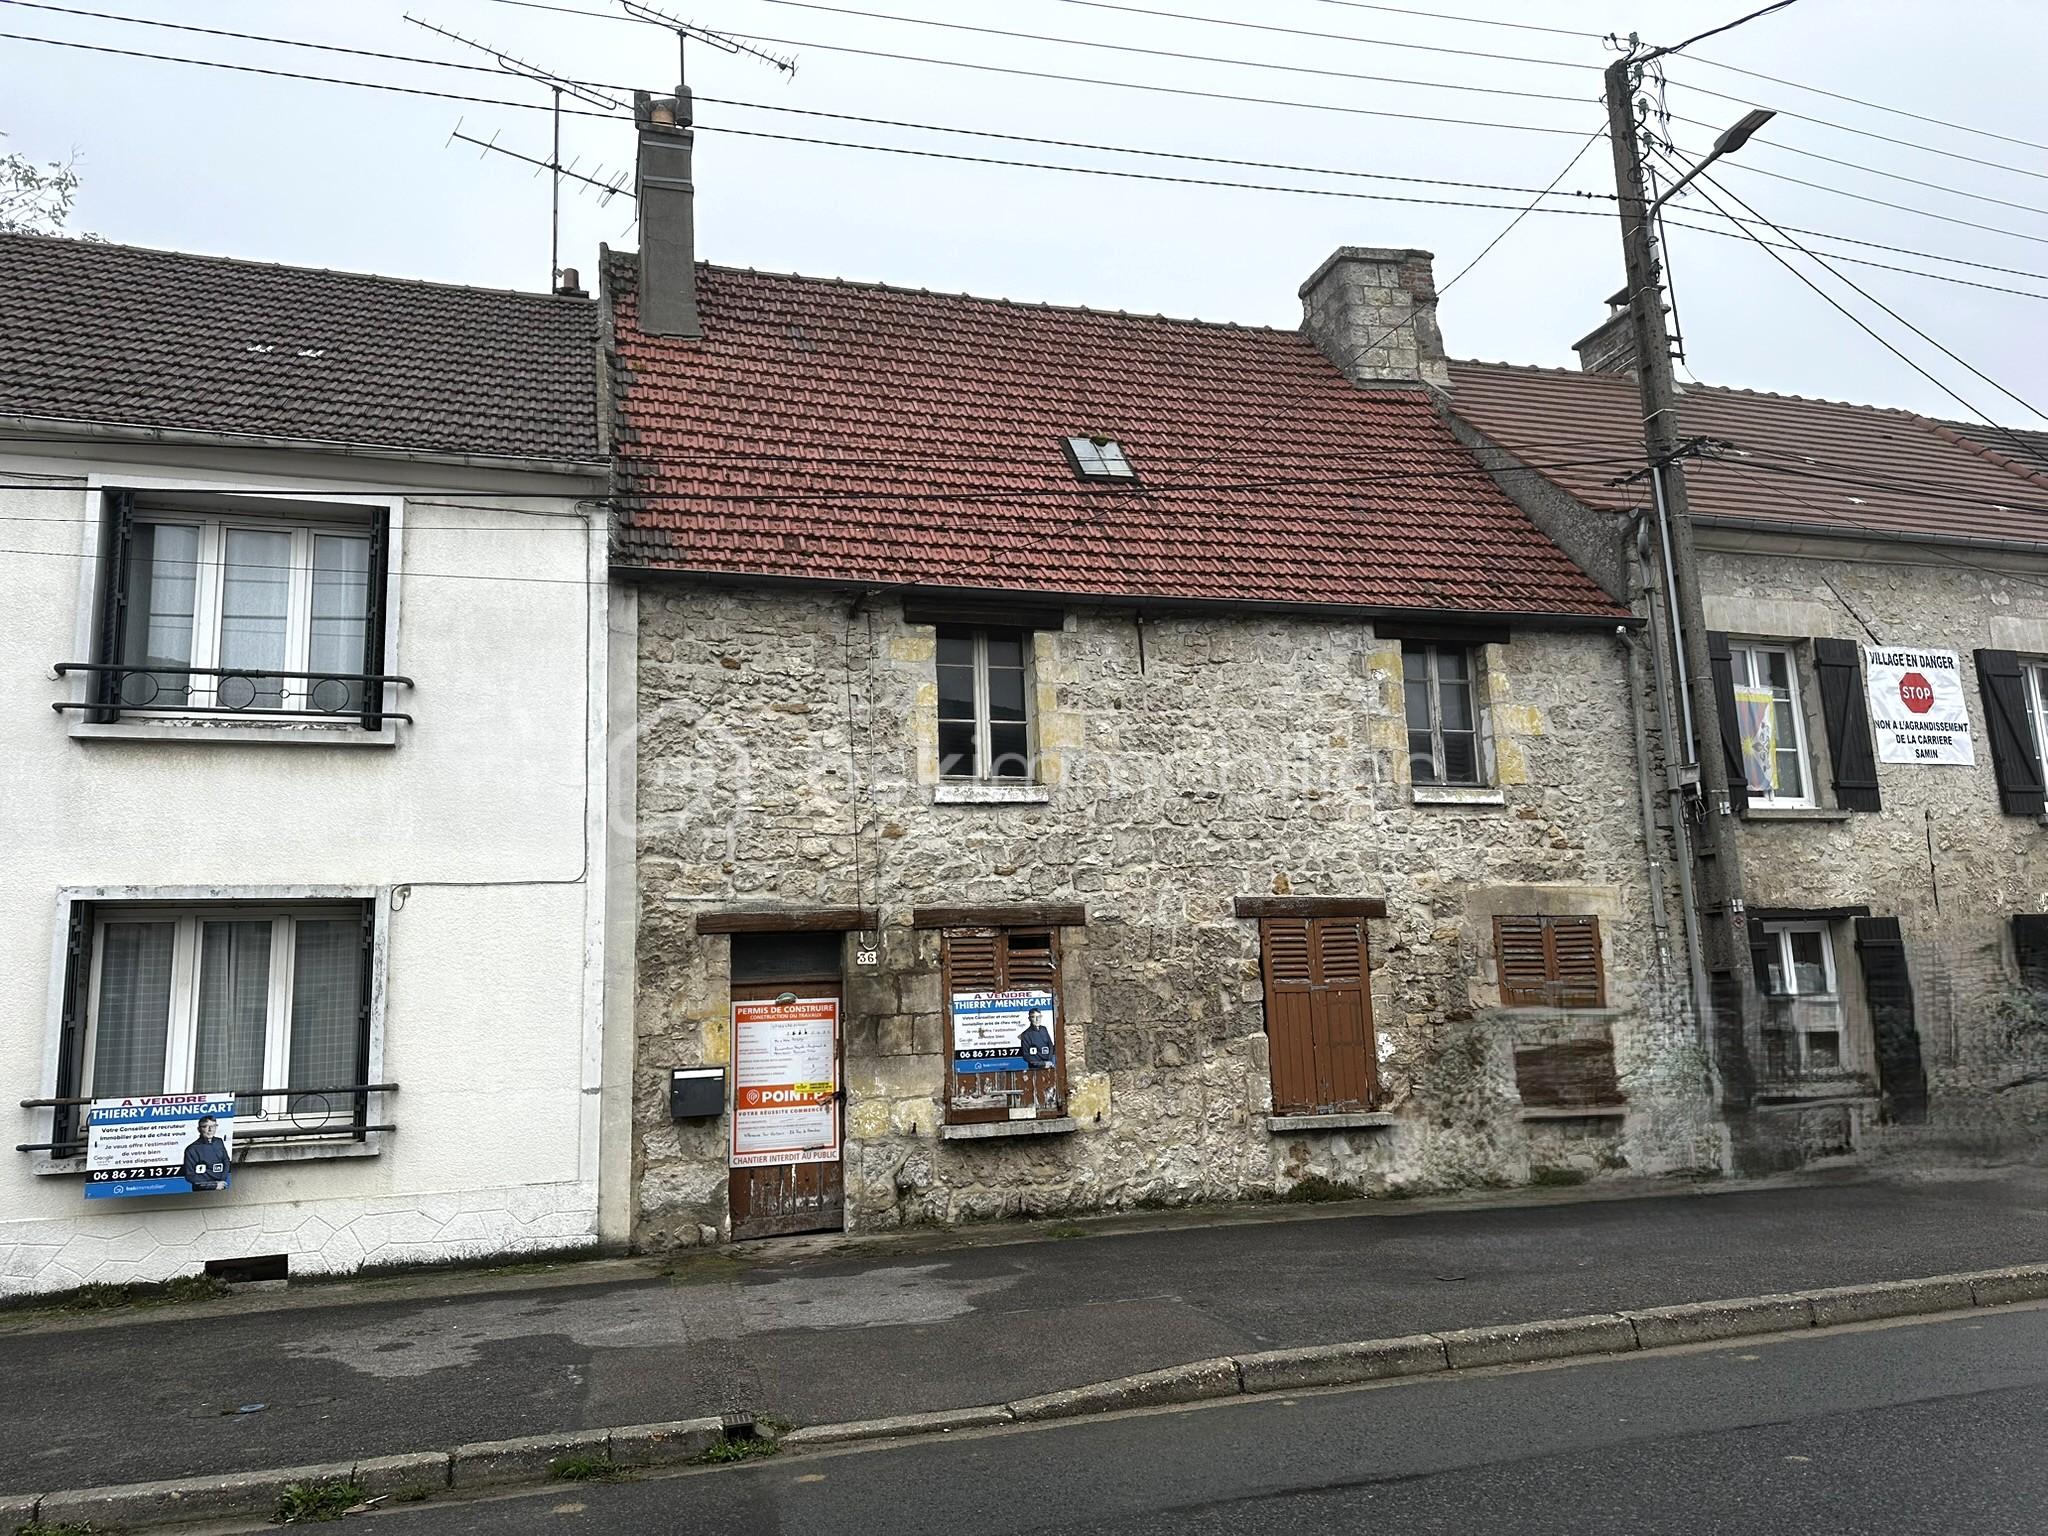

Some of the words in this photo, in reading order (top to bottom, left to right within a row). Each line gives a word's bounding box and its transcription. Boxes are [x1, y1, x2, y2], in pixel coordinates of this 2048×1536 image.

[1869, 651, 1905, 666] VILLAGE
[1906, 653, 1918, 667] EN
[1919, 655, 1955, 669] DANGER
[1902, 686, 1931, 700] STOP
[1875, 719, 1891, 729] NON
[1892, 721, 1898, 729] A
[1899, 720, 1968, 732] L'AGRANDISSEMENT
[1896, 734, 1905, 744] DE
[1907, 735, 1917, 744] LA
[1918, 735, 1953, 745] CARRIERE
[1915, 748, 1939, 758] SAMIN
[859, 953, 874, 963] 36
[737, 1006, 769, 1015] PERMIS
[770, 1005, 782, 1014] DE
[783, 1004, 834, 1013] CONSTRUIRE
[954, 1001, 992, 1010] THIERRY
[995, 998, 1051, 1008] MENNECART
[959, 1051, 971, 1059] 06
[972, 1050, 983, 1058] 86
[984, 1049, 996, 1057] 72
[1009, 1048, 1020, 1056] 77
[140, 1095, 207, 1106] VENDRE
[91, 1107, 148, 1120] THIERRY
[151, 1102, 234, 1117] MENNECART
[119, 1125, 150, 1133] Conseiller
[133, 1133, 147, 1142] près
[135, 1156, 169, 1165] diagnostics
[733, 1155, 768, 1165] CHANTIER
[769, 1153, 800, 1163] INTERDIT
[801, 1151, 812, 1160] AU
[813, 1150, 837, 1159] PUBLIC
[93, 1171, 109, 1181] 06
[111, 1169, 127, 1180] 86
[129, 1169, 145, 1178] 72
[149, 1167, 163, 1177] 13
[166, 1165, 182, 1175] 77
